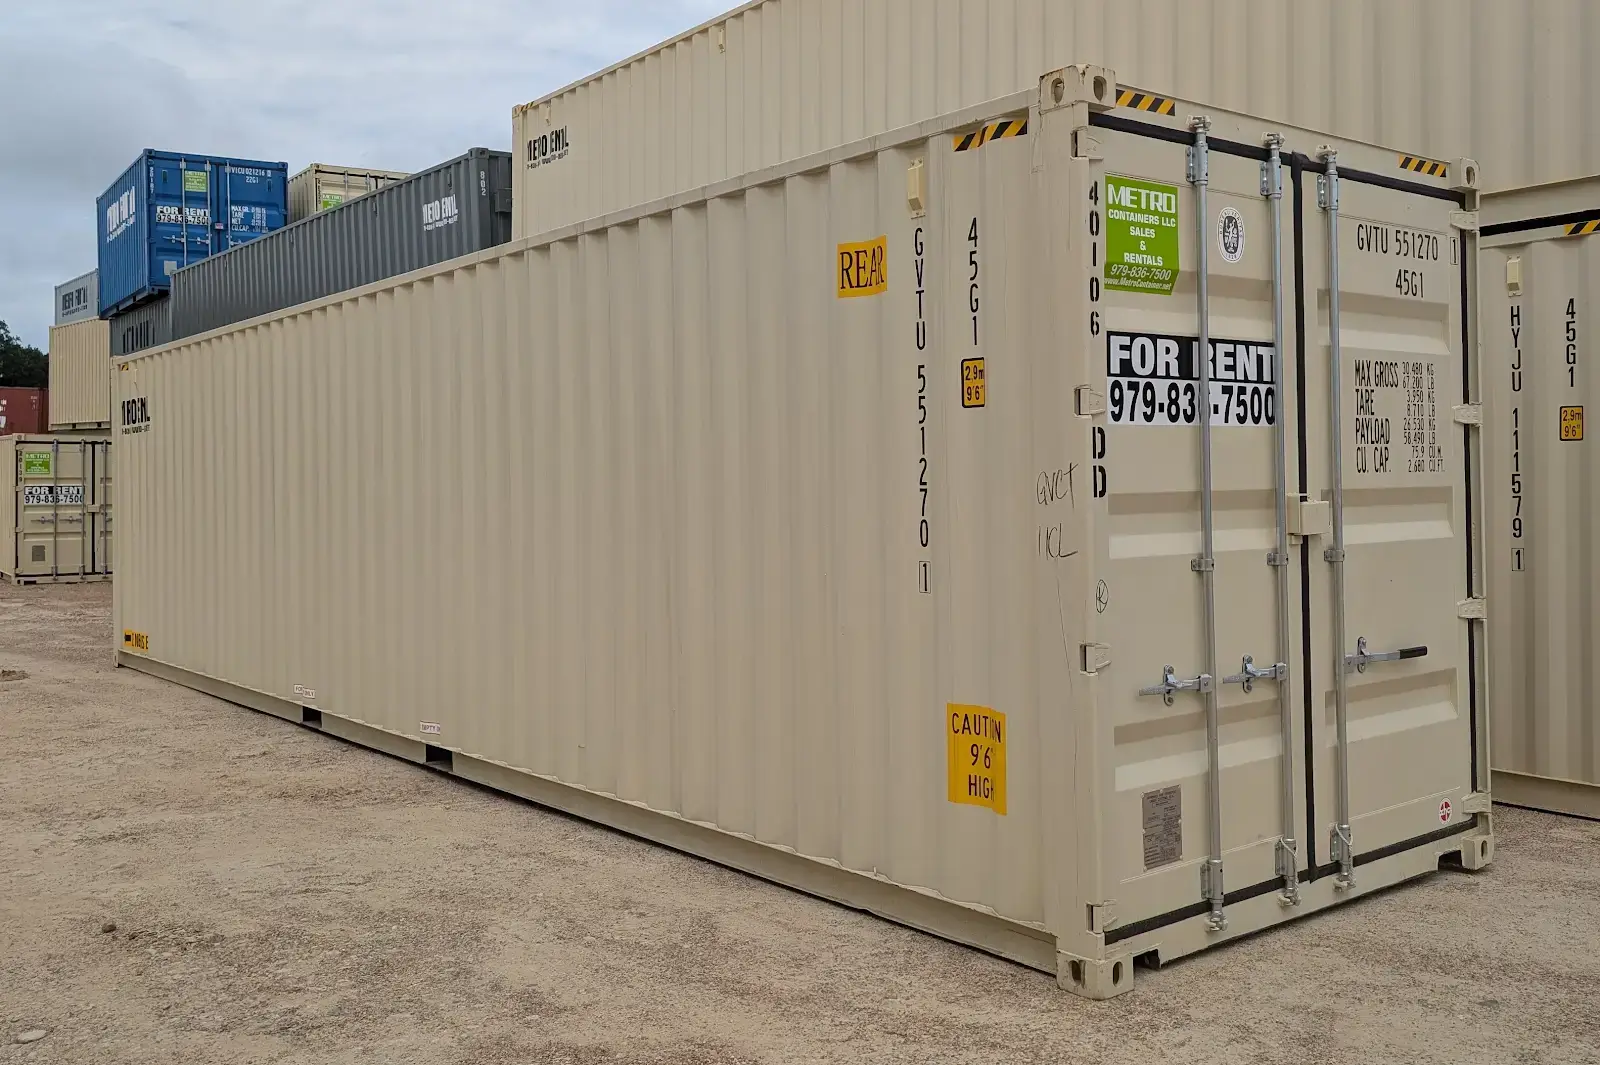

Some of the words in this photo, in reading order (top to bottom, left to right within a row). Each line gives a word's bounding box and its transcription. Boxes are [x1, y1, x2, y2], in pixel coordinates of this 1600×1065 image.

[156, 206, 179, 214] FOR
[1107, 183, 1176, 214] METRO
[1108, 209, 1160, 226] CONTAINERS
[1161, 216, 1176, 228] LLC
[1129, 225, 1156, 239] SALES
[1139, 240, 1147, 251] &
[1357, 223, 1388, 254] GVTU
[1395, 229, 1439, 261] 551270
[839, 245, 885, 290] REAR
[1110, 263, 1172, 281] 979-836-7500
[1123, 252, 1163, 267] RENTALS
[914, 227, 926, 351] GVTU
[967, 216, 979, 346] 45G1
[1395, 268, 1424, 298] 45G1
[1109, 335, 1181, 378] FOR
[1510, 305, 1522, 392] HYJU
[1565, 298, 1576, 388] 45G1
[1354, 359, 1371, 387] MAX
[1374, 360, 1399, 388] GROSS
[1109, 379, 1276, 425] 979-83-7500
[1355, 388, 1375, 416] TARE
[1355, 417, 1391, 445] PAYLOAD
[917, 364, 930, 548] 551270
[1356, 446, 1369, 474] CU.
[1373, 446, 1392, 473] CAP.
[1510, 407, 1523, 538] 111579
[24, 486, 50, 495] FOR
